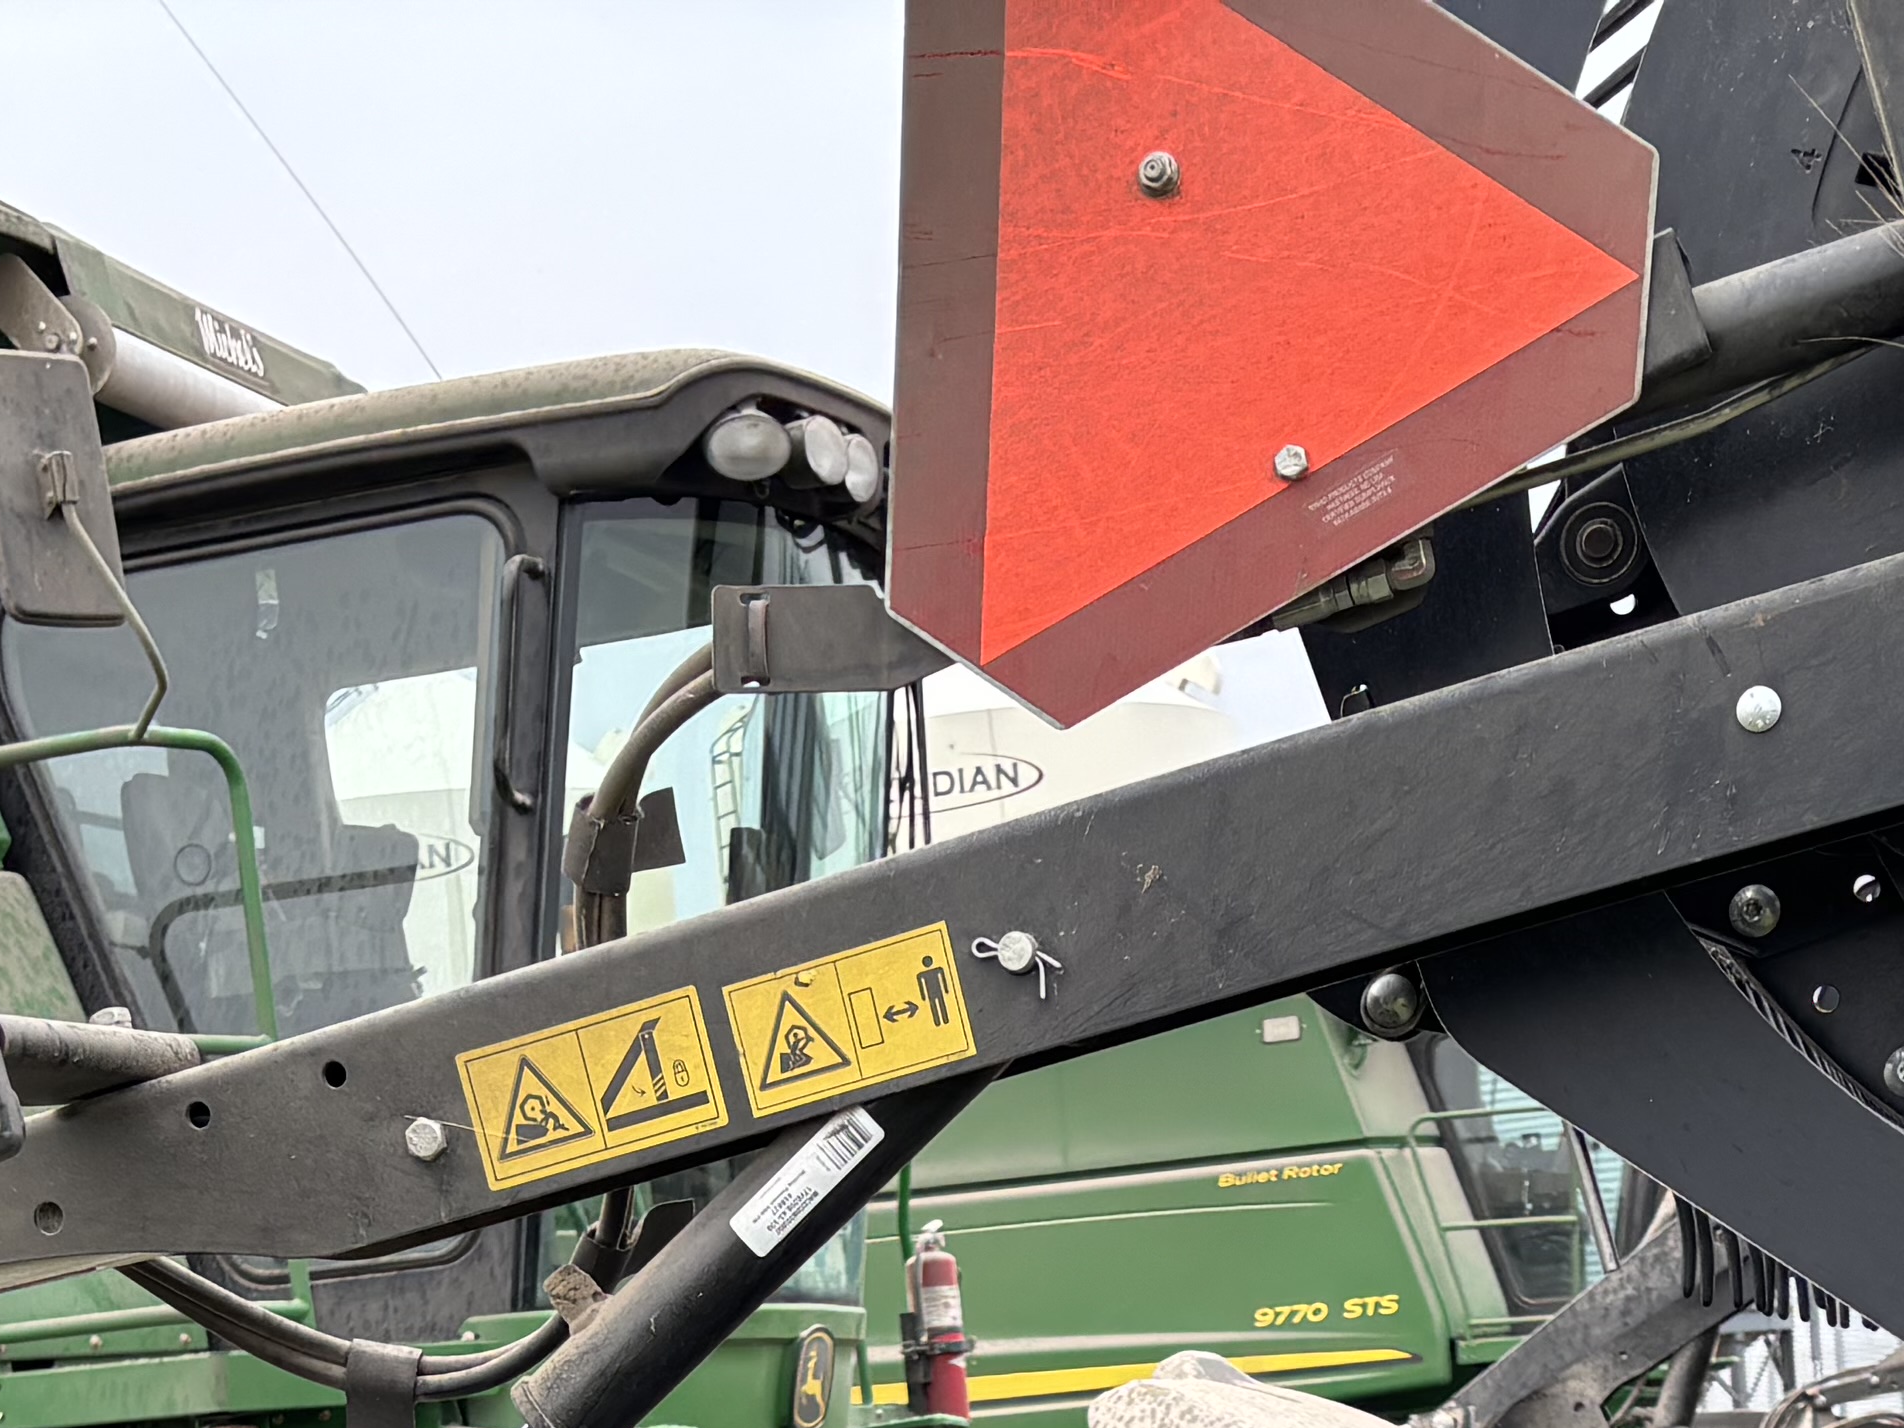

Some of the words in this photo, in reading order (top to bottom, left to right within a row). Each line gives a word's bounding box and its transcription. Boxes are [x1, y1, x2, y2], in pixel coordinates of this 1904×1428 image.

[1217, 1170, 1278, 1187] Bullet
[1282, 1163, 1343, 1180] Rotor
[1253, 1302, 1329, 1328] 9770
[1342, 1294, 1400, 1319] STS
